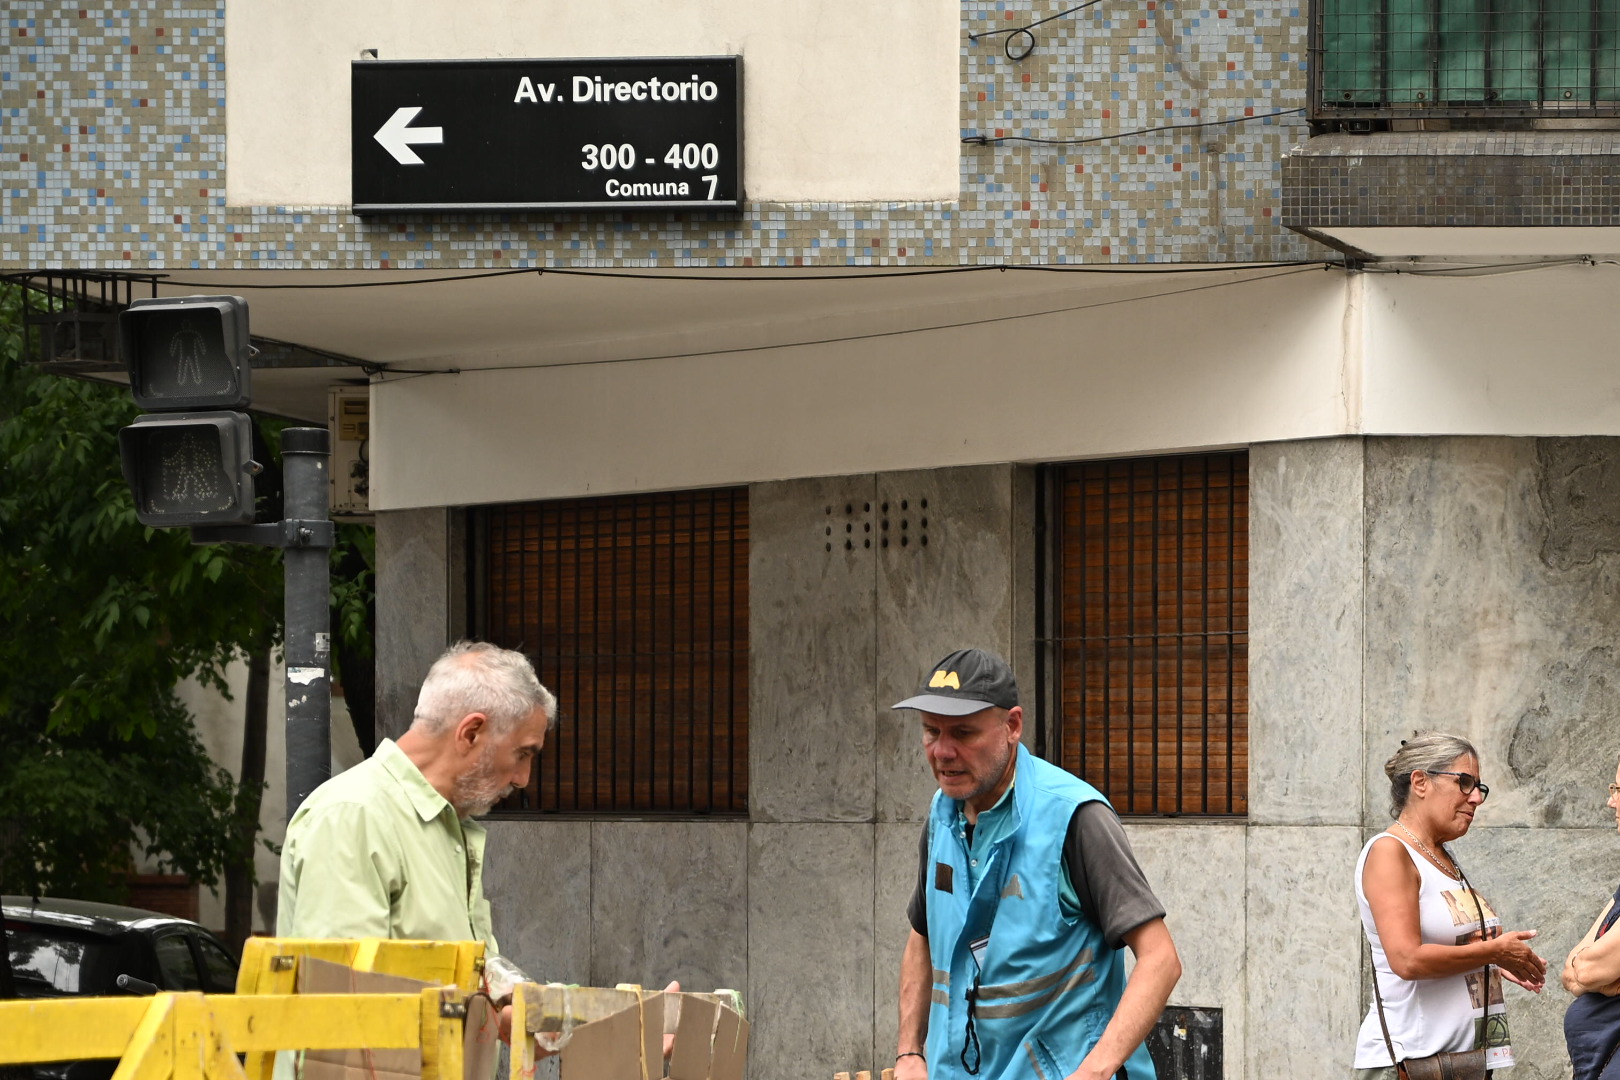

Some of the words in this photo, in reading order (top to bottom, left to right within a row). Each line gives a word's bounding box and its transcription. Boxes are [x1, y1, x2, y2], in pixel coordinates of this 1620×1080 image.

[513, 76, 564, 103] Av.
[572, 75, 718, 103] Directorio
[581, 143, 636, 170] 300
[663, 143, 719, 169] 400
[605, 178, 689, 197] Comuna
[701, 175, 719, 201] 7
